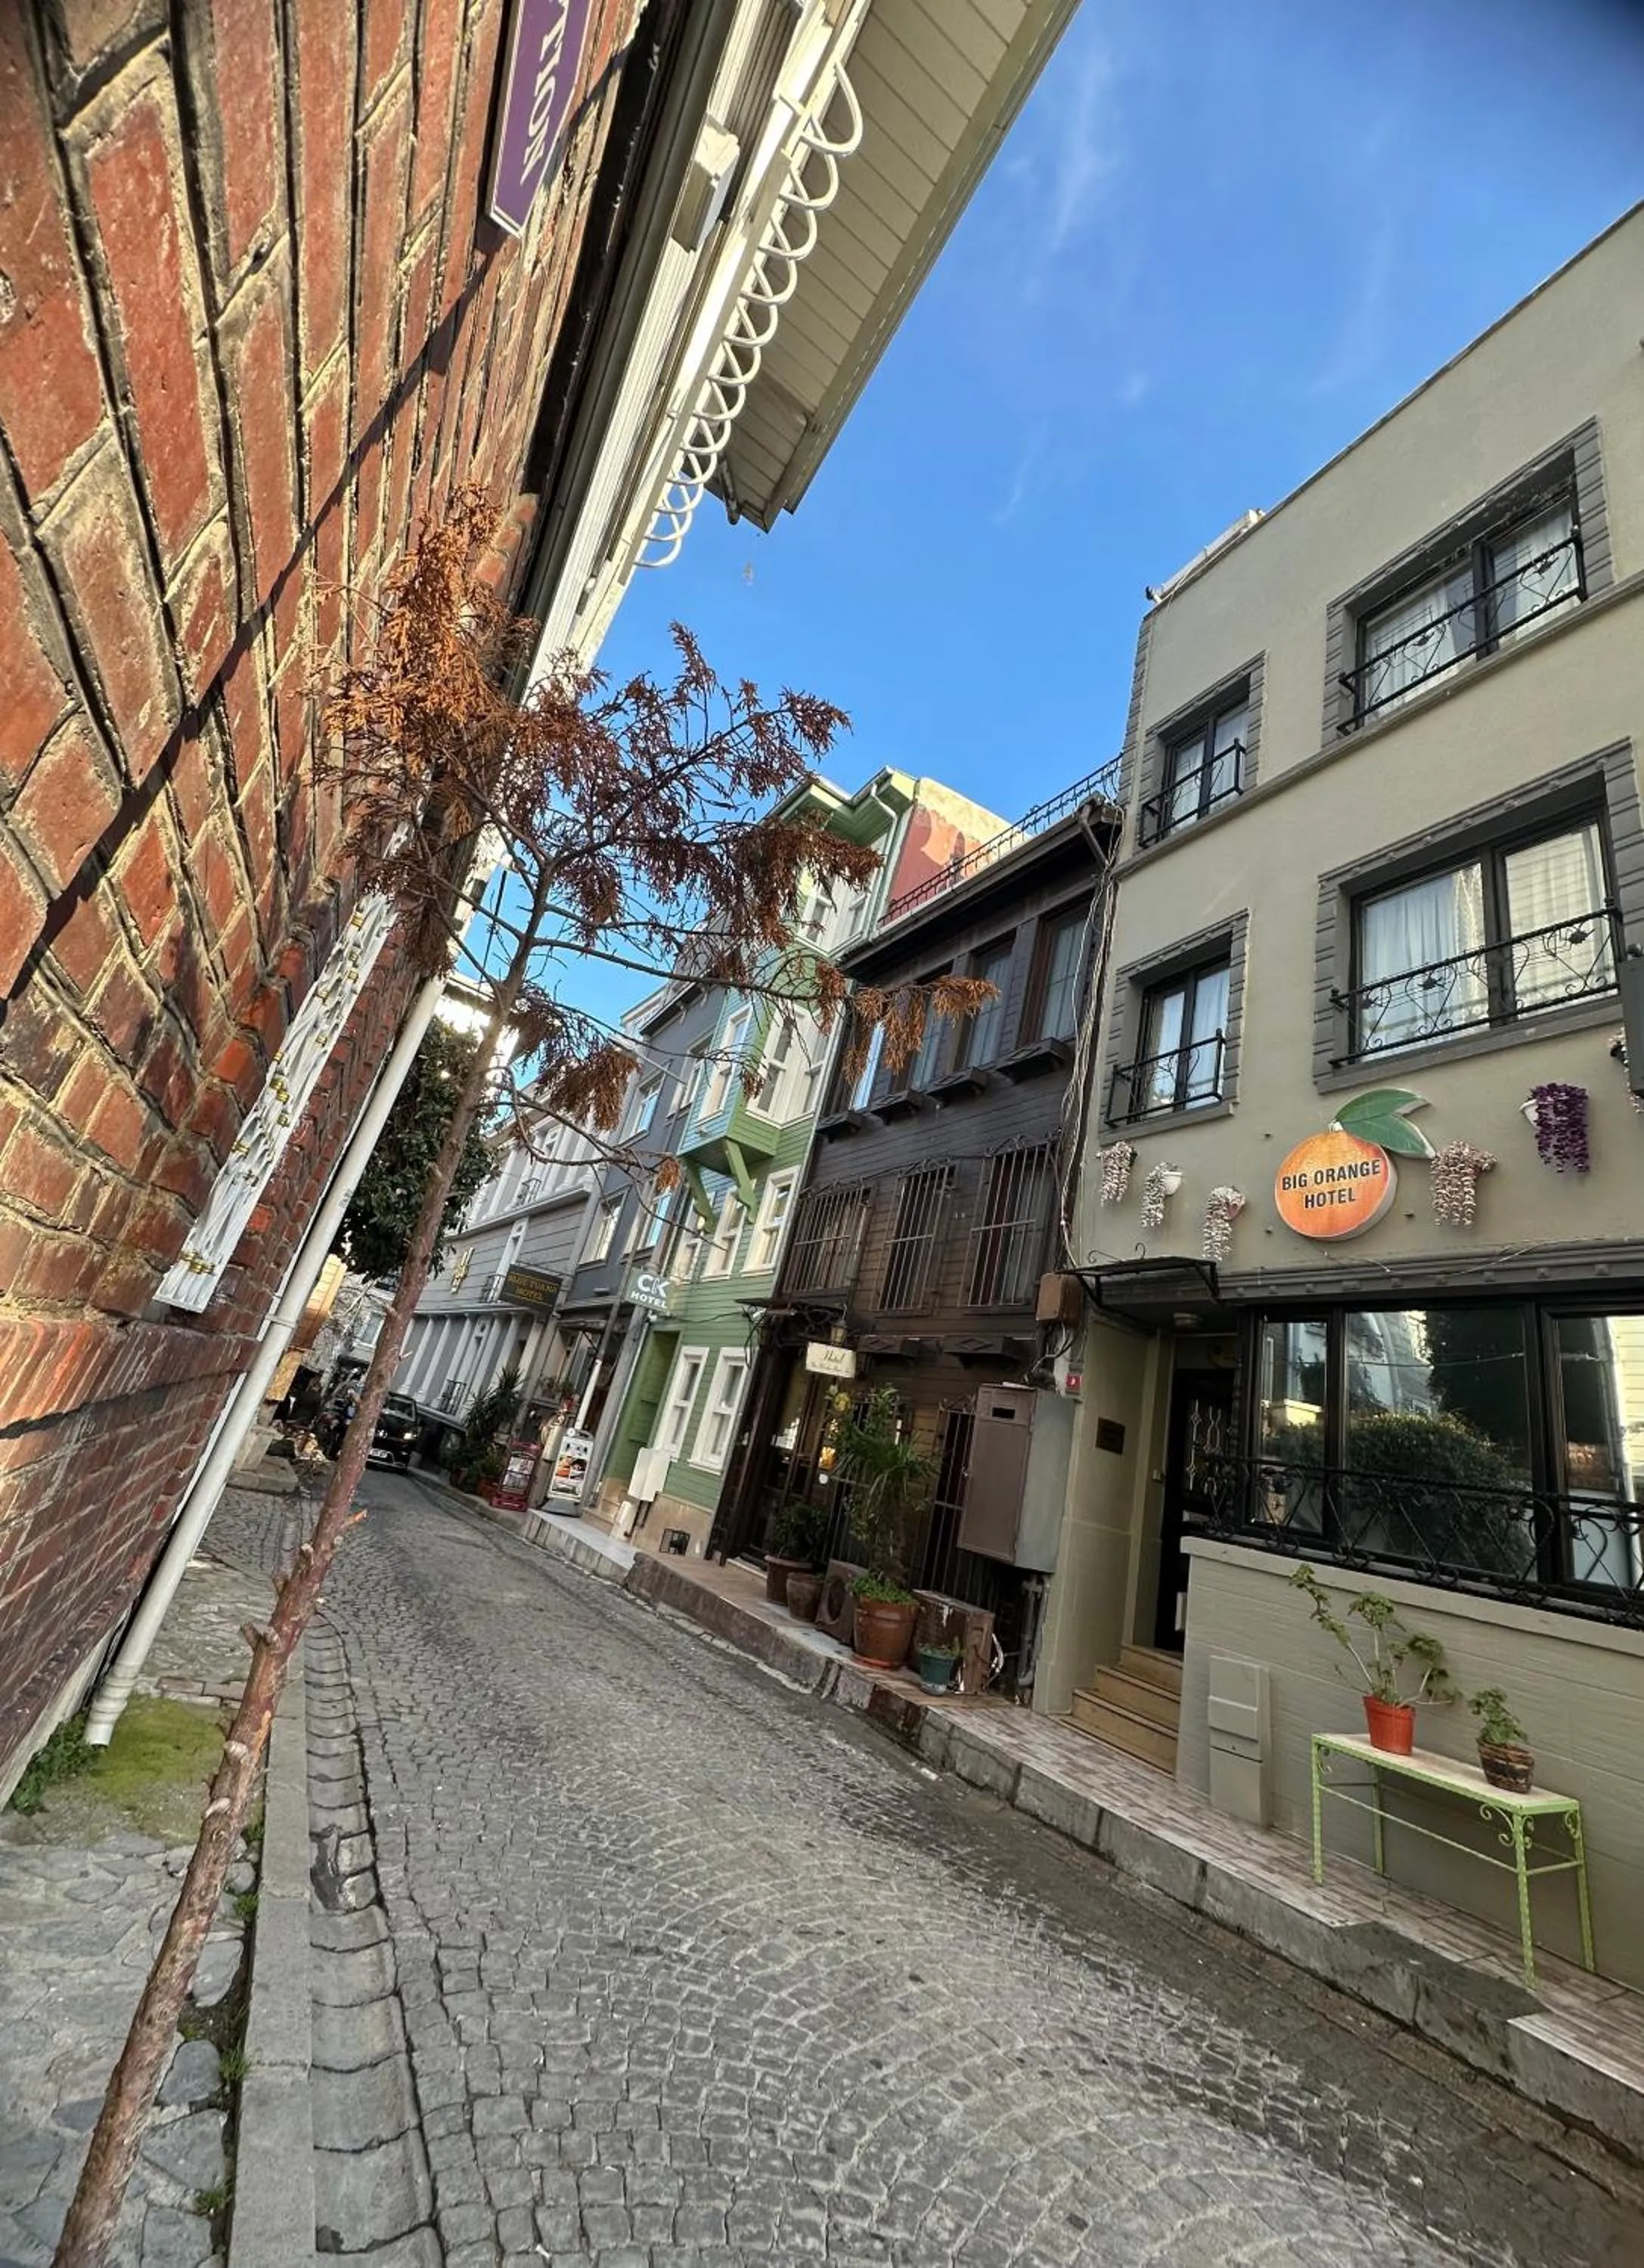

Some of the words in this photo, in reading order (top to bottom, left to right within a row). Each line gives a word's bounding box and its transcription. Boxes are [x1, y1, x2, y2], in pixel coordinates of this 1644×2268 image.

[520, 0, 569, 184] TION
[1282, 1173, 1307, 1191] BIG
[1314, 1159, 1381, 1185] ORANGE
[1304, 1188, 1356, 1209] HOTEL
[630, 1290, 667, 1309] HOTEL
